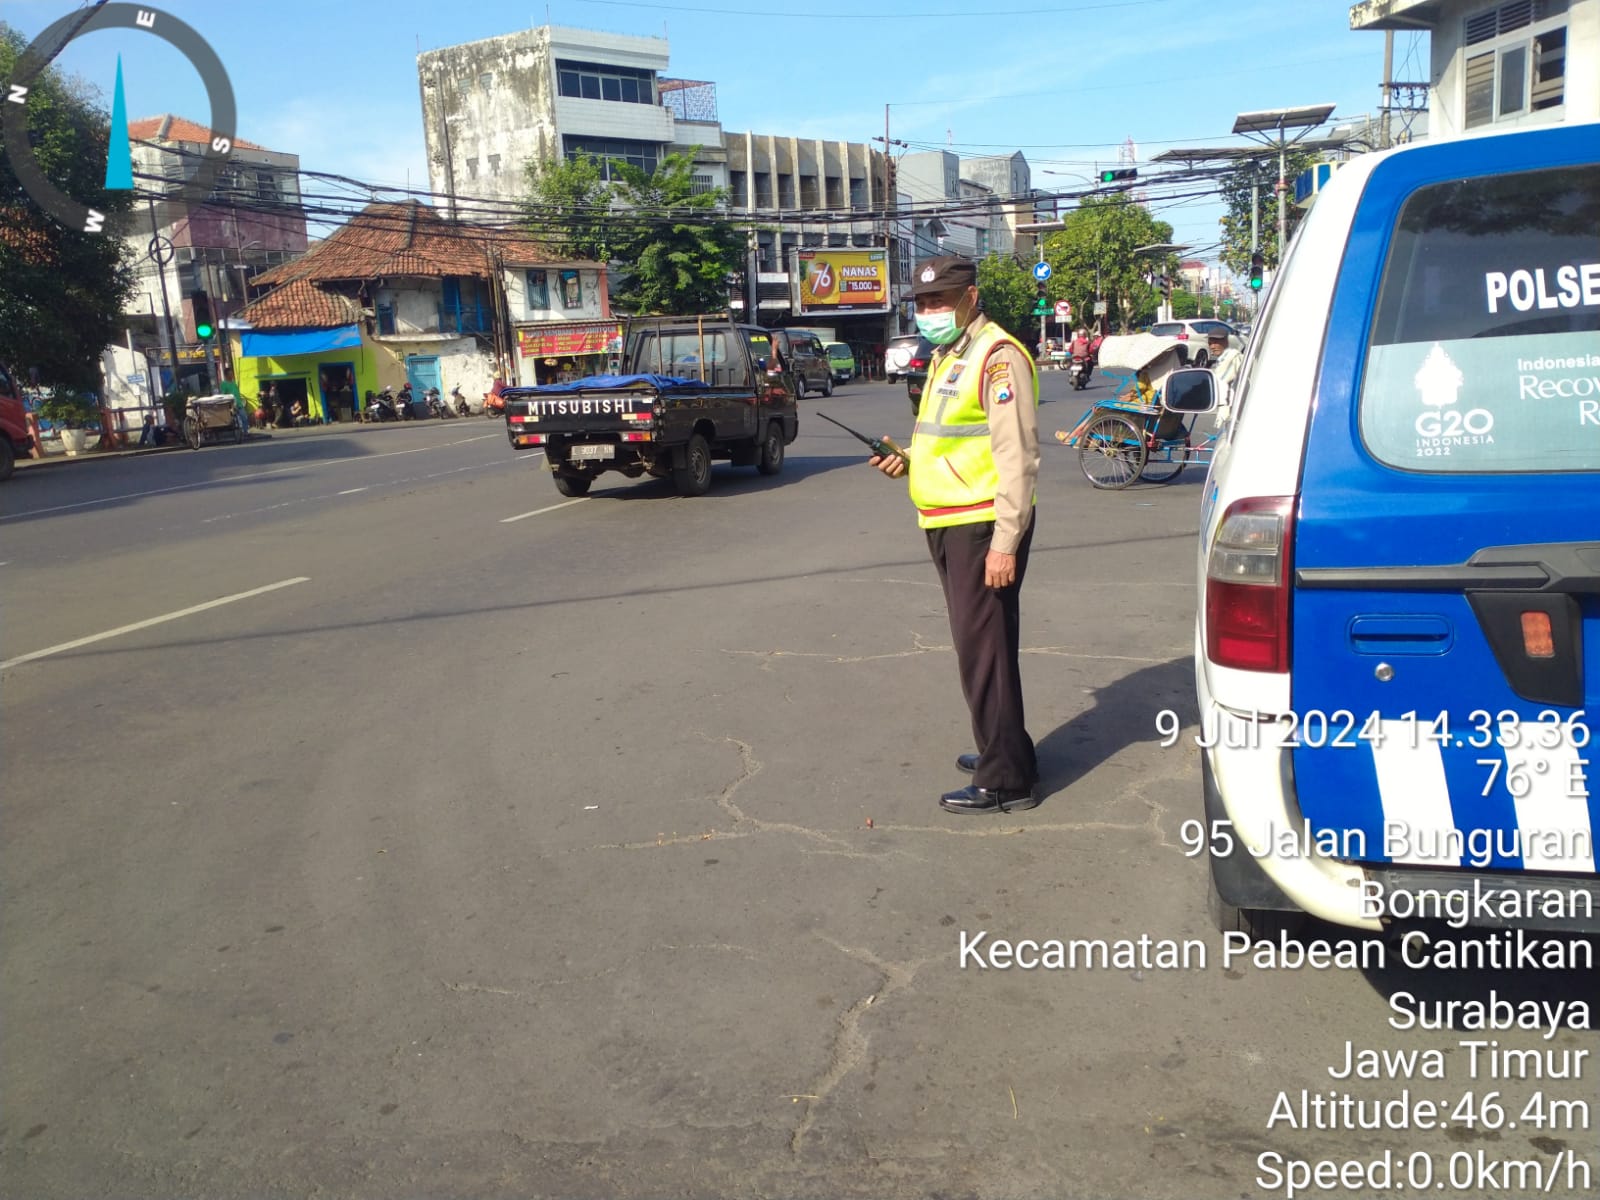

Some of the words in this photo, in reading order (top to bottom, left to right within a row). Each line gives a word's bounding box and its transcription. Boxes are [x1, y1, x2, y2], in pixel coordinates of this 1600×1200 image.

[810, 264, 831, 294] 76
[842, 267, 877, 277] NANAS
[1486, 264, 1600, 313] POLSE
[1518, 353, 1600, 371] Indonesia
[528, 399, 633, 416] MITSUBISHI
[1416, 408, 1494, 437] G20
[1416, 435, 1494, 448] INDONESIA
[1416, 446, 1451, 457] 2022
